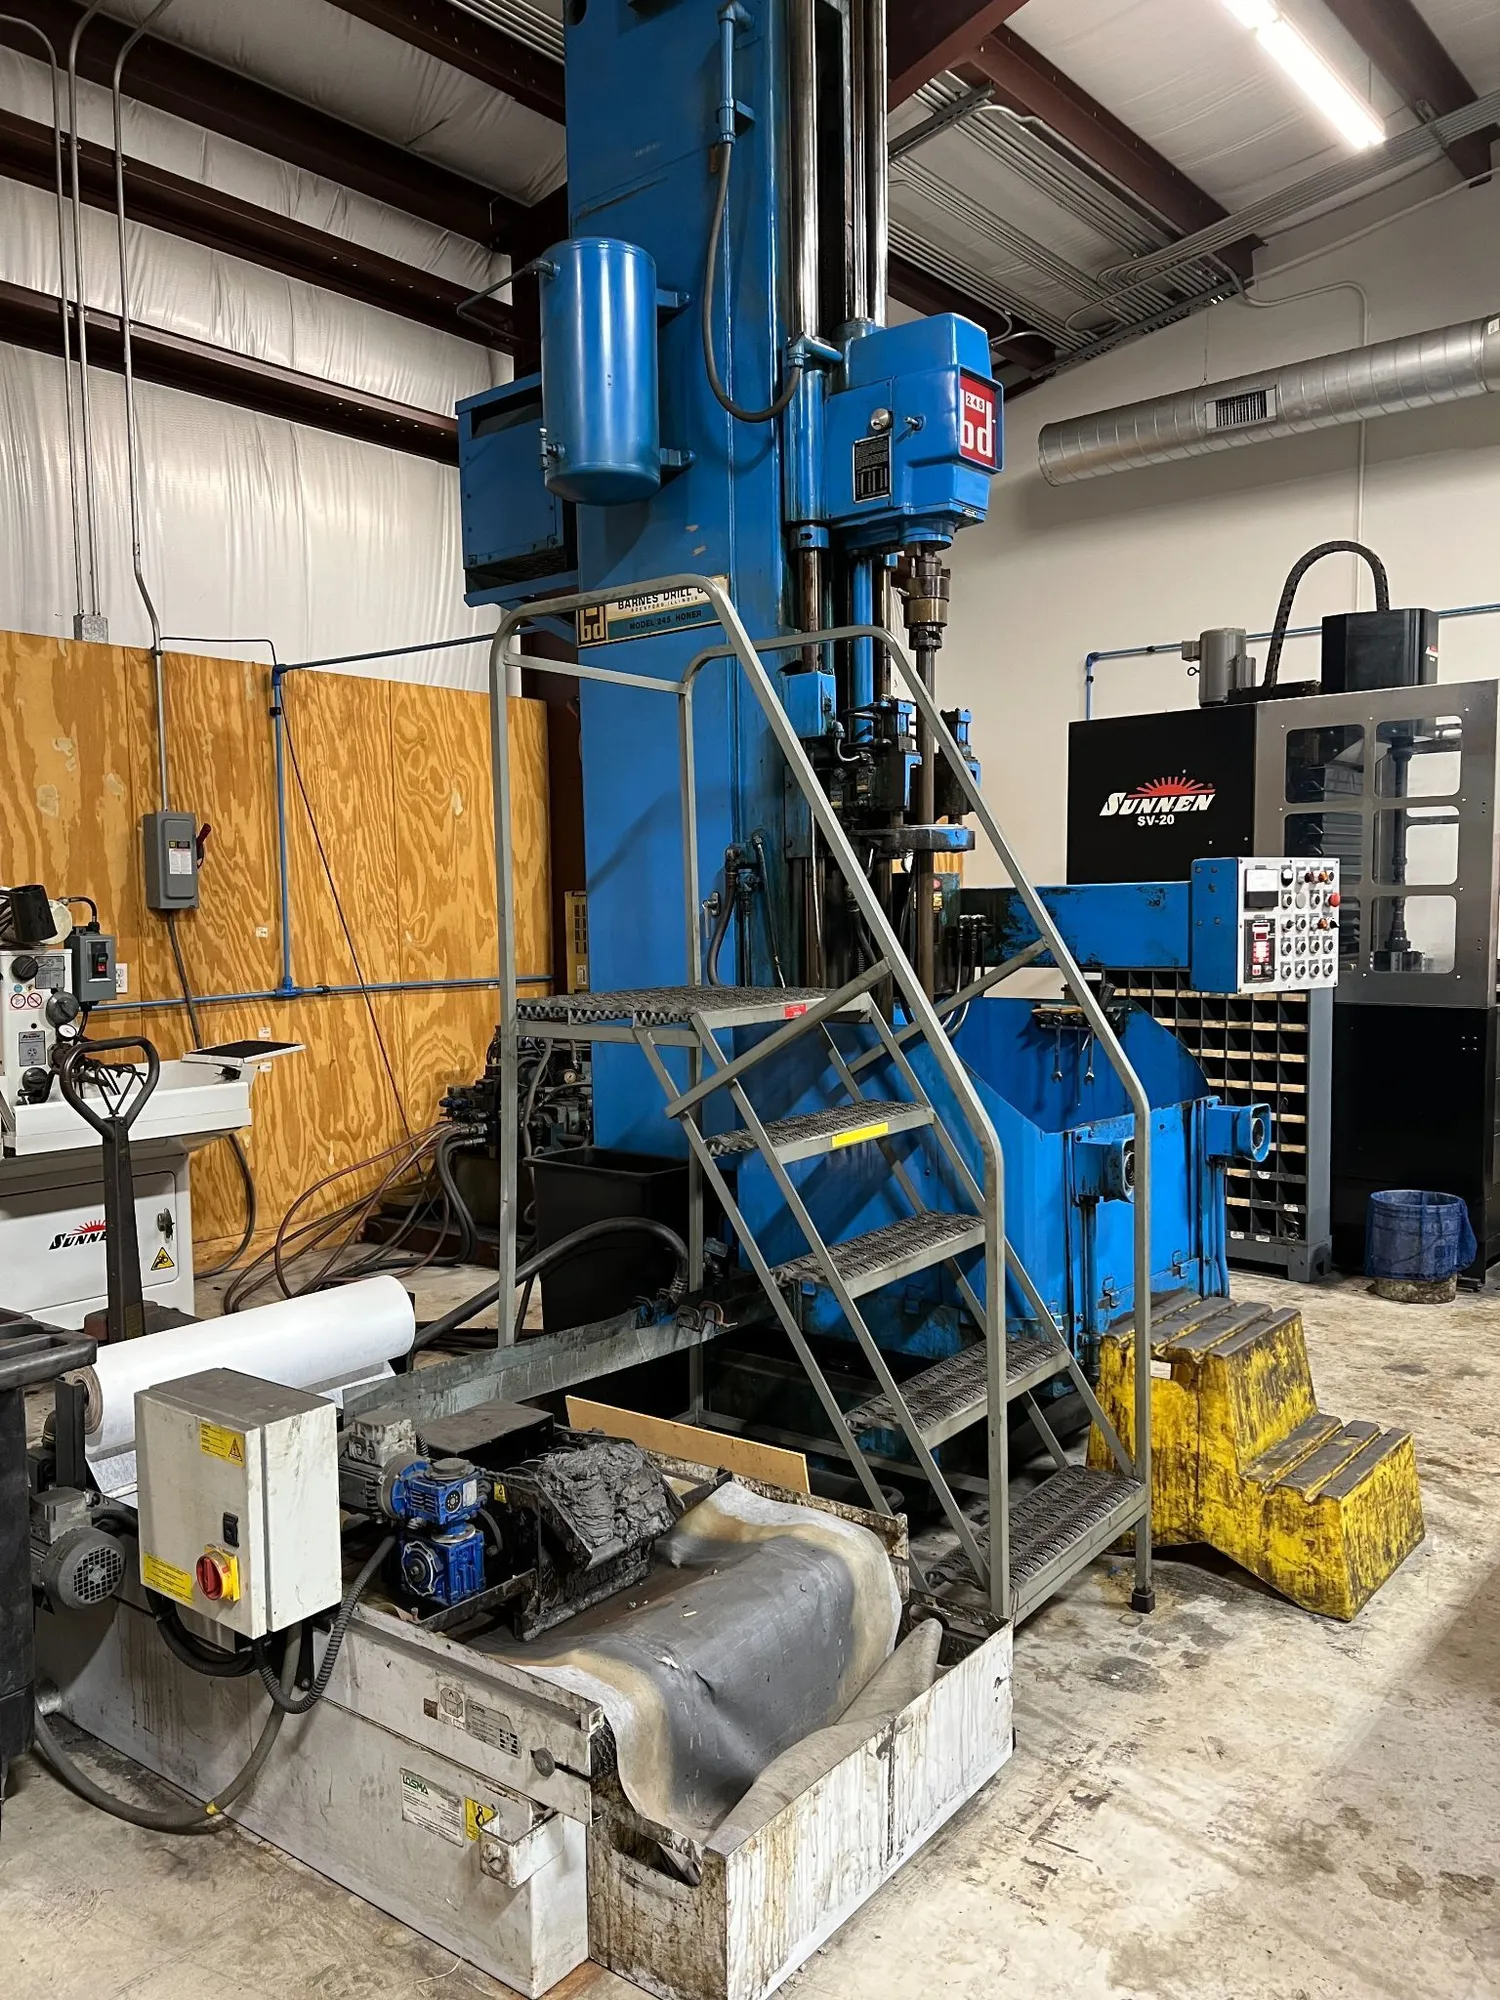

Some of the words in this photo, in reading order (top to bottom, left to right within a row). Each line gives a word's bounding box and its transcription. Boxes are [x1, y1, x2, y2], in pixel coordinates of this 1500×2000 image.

[966, 395, 984, 410] 245
[618, 594, 659, 610] BARNES
[663, 588, 692, 601] DRILL
[629, 618, 654, 630] MODEL
[657, 615, 671, 626] 245
[676, 610, 702, 622] HONER
[1137, 814, 1175, 826] SV-20
[49, 1232, 107, 1250] SUNNE
